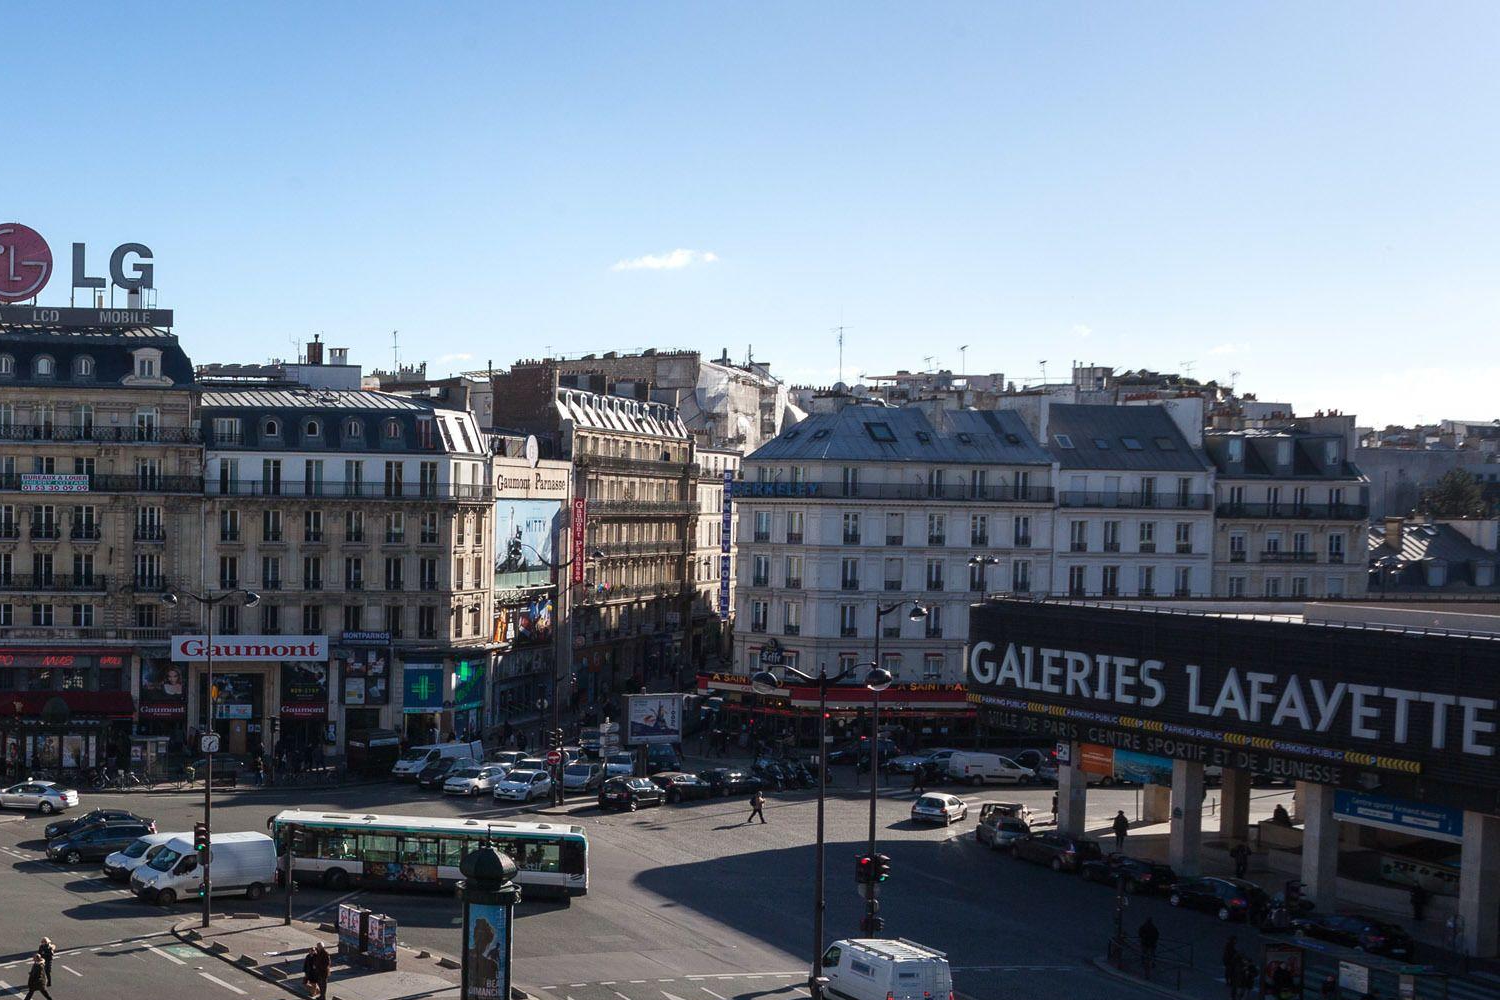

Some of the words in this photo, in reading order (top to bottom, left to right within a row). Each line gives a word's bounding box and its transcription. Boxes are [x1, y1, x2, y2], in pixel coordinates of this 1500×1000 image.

[72, 242, 154, 290] LG
[33, 308, 60, 322] LCD
[99, 309, 151, 324] MOBILE
[497, 474, 531, 491] Gaumont
[535, 472, 566, 490] Parnasse
[722, 472, 732, 551] BERKELEY
[525, 520, 546, 533] MITTY
[720, 556, 730, 607] HOTEL
[180, 639, 319, 657] Gaumont
[970, 641, 1166, 708] GALERIES
[909, 682, 940, 692] SAINT
[140, 705, 185, 713] Gaumont
[281, 705, 325, 713] Gaumont
[981, 695, 1006, 706] PARKING
[1005, 699, 1028, 710] PUBLIC
[1185, 664, 1498, 756] LAFAYETTE
[1066, 709, 1095, 720] PARKING
[1096, 713, 1119, 724] PUBLIC
[1163, 723, 1195, 736] PARKING
[1196, 729, 1223, 741] PUBLIC
[988, 710, 1017, 729] VILLE
[1024, 716, 1038, 732] DE
[1044, 719, 1078, 739] PARIS
[1088, 727, 1141, 750] CENTRE
[1146, 736, 1206, 761] SPORTIF
[1214, 748, 1231, 765] ET
[1237, 752, 1258, 771] DE
[1264, 757, 1342, 785] JEUNESSE
[1274, 742, 1311, 755] PARKING
[1312, 747, 1344, 760] PUBLIC
